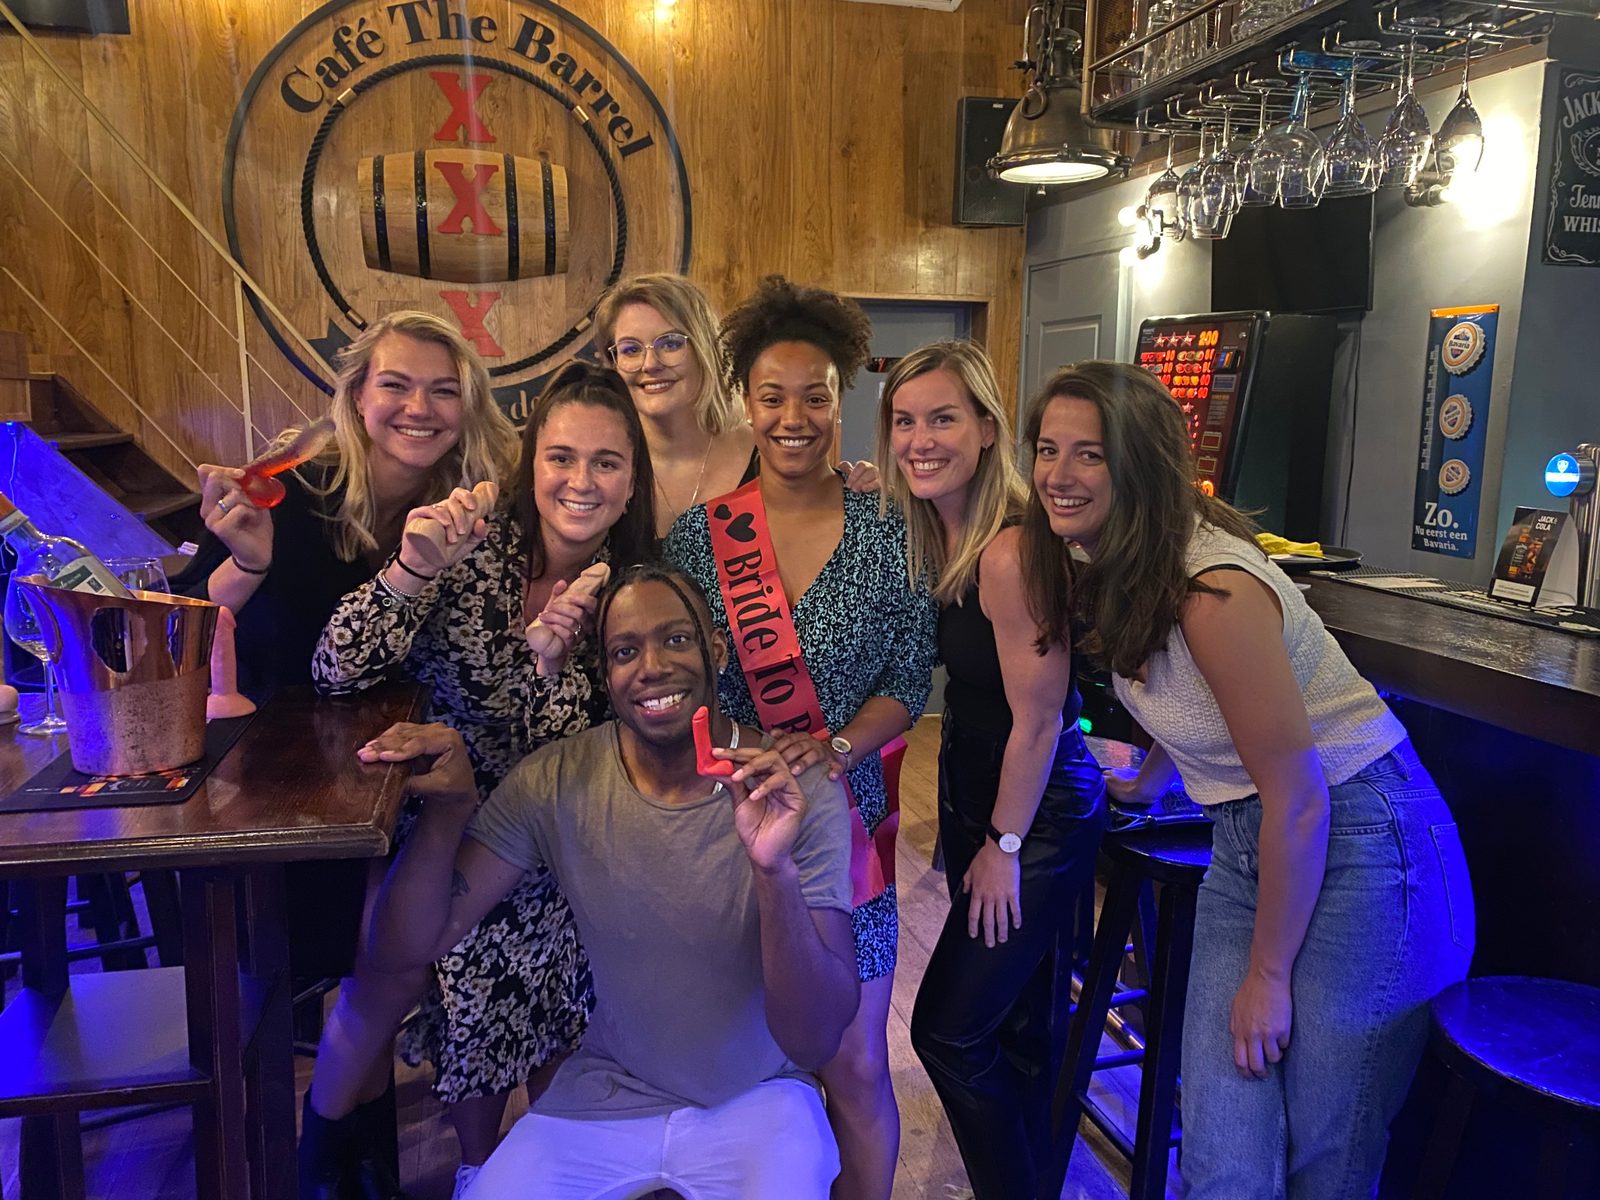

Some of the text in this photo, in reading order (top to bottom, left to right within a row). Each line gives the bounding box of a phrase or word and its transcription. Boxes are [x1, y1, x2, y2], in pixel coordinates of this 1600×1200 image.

[281, 0, 654, 159] Café The Barrel
[430, 71, 497, 143] X
[434, 161, 503, 235] X
[1424, 501, 1459, 528] Zo.
[1426, 529, 1447, 539] eerst
[1449, 531, 1468, 540] een
[1535, 523, 1551, 531] COLA
[724, 549, 783, 655] Bride
